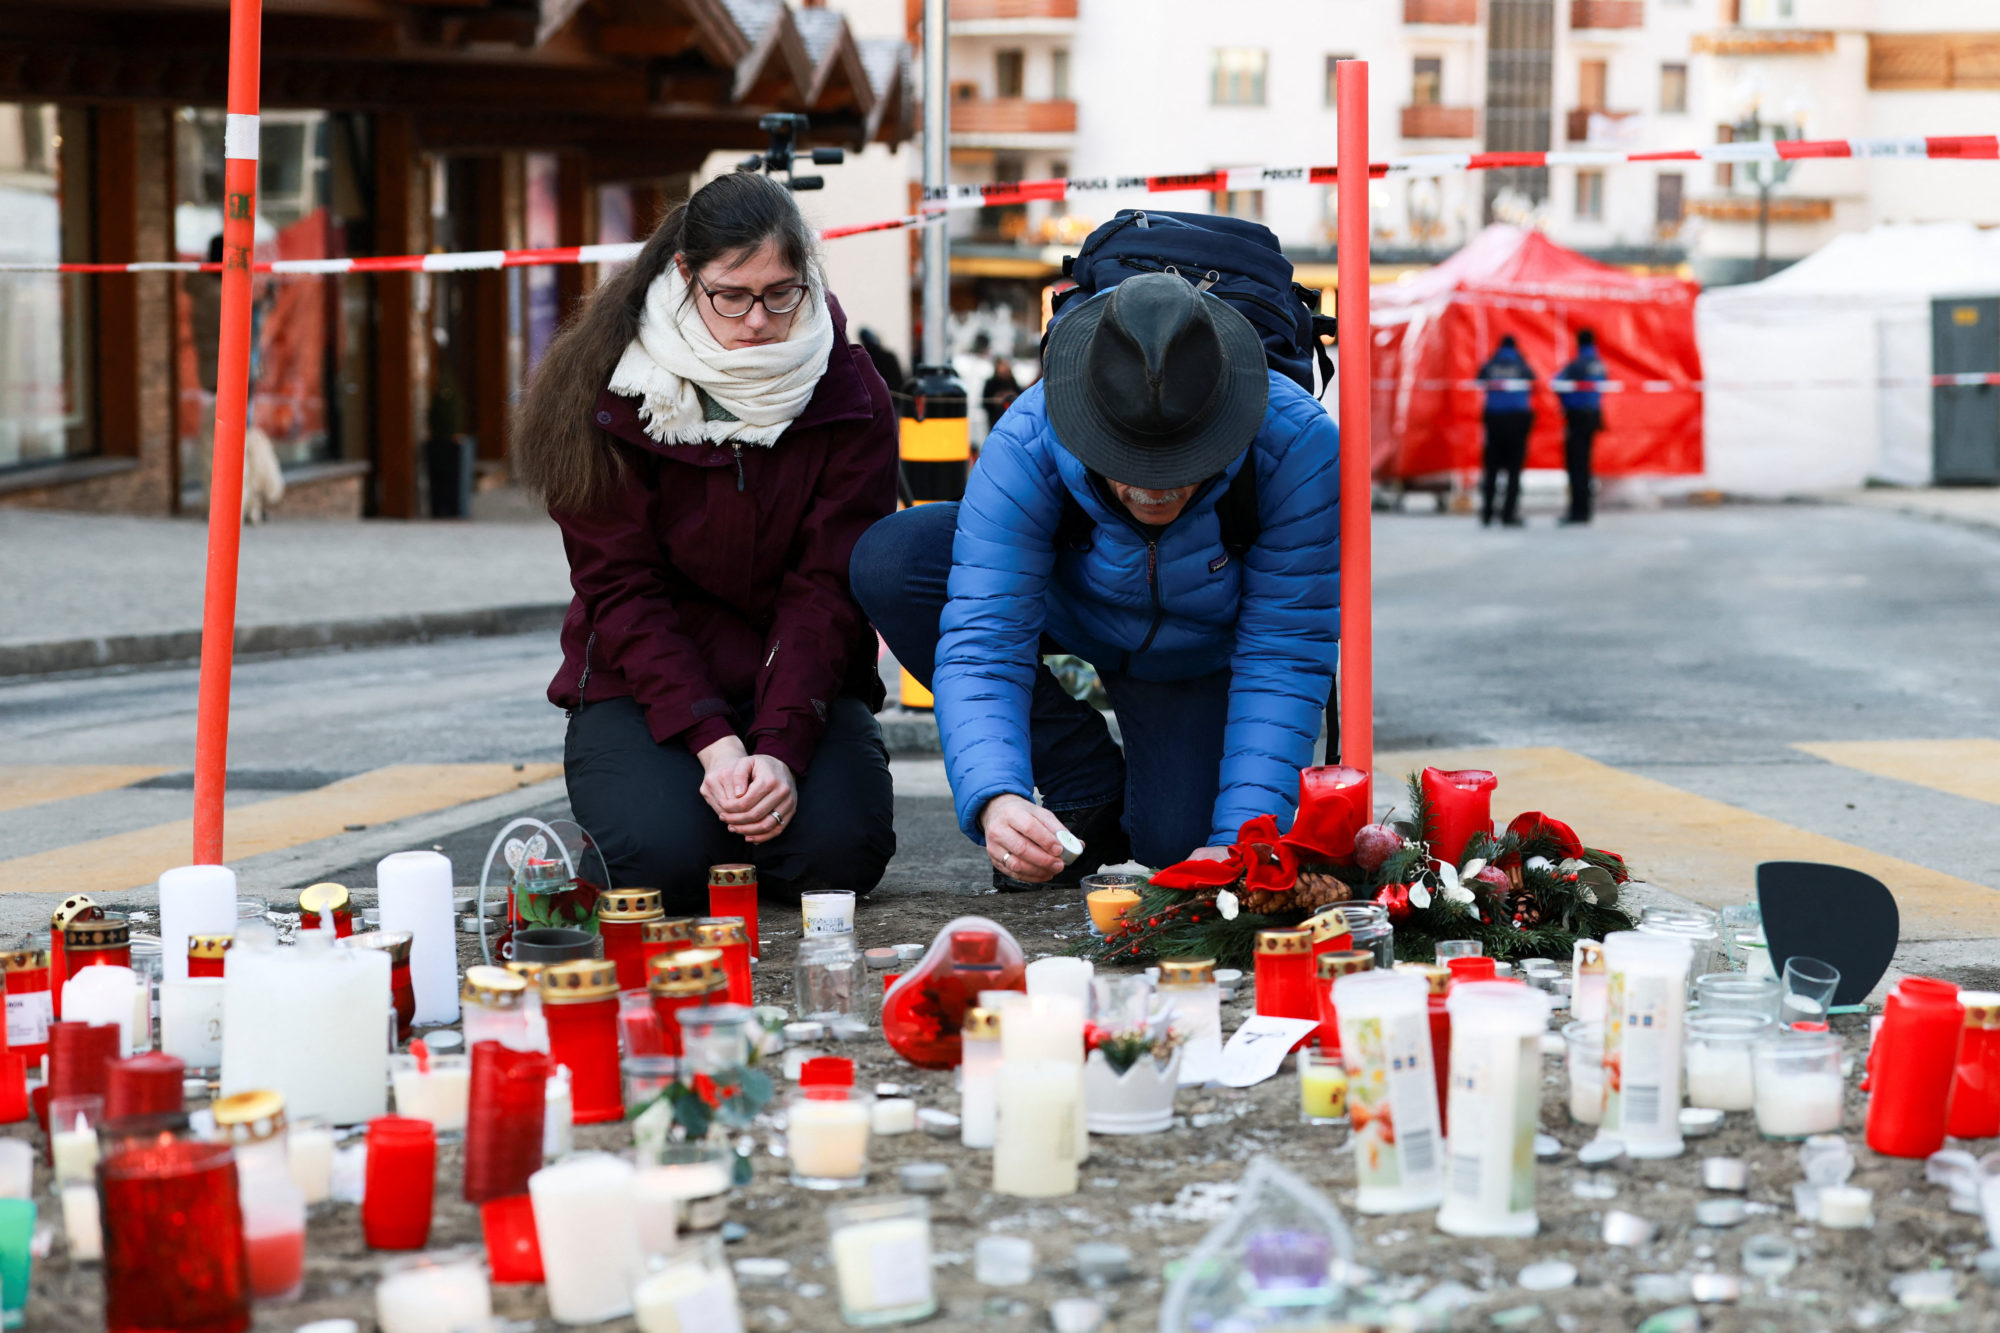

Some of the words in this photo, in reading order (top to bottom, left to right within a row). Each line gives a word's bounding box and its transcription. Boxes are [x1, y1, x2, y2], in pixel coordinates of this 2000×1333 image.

[1067, 176, 1108, 190] POLICE
[1116, 175, 1147, 189] ZONE
[1262, 167, 1303, 180] POLICE
